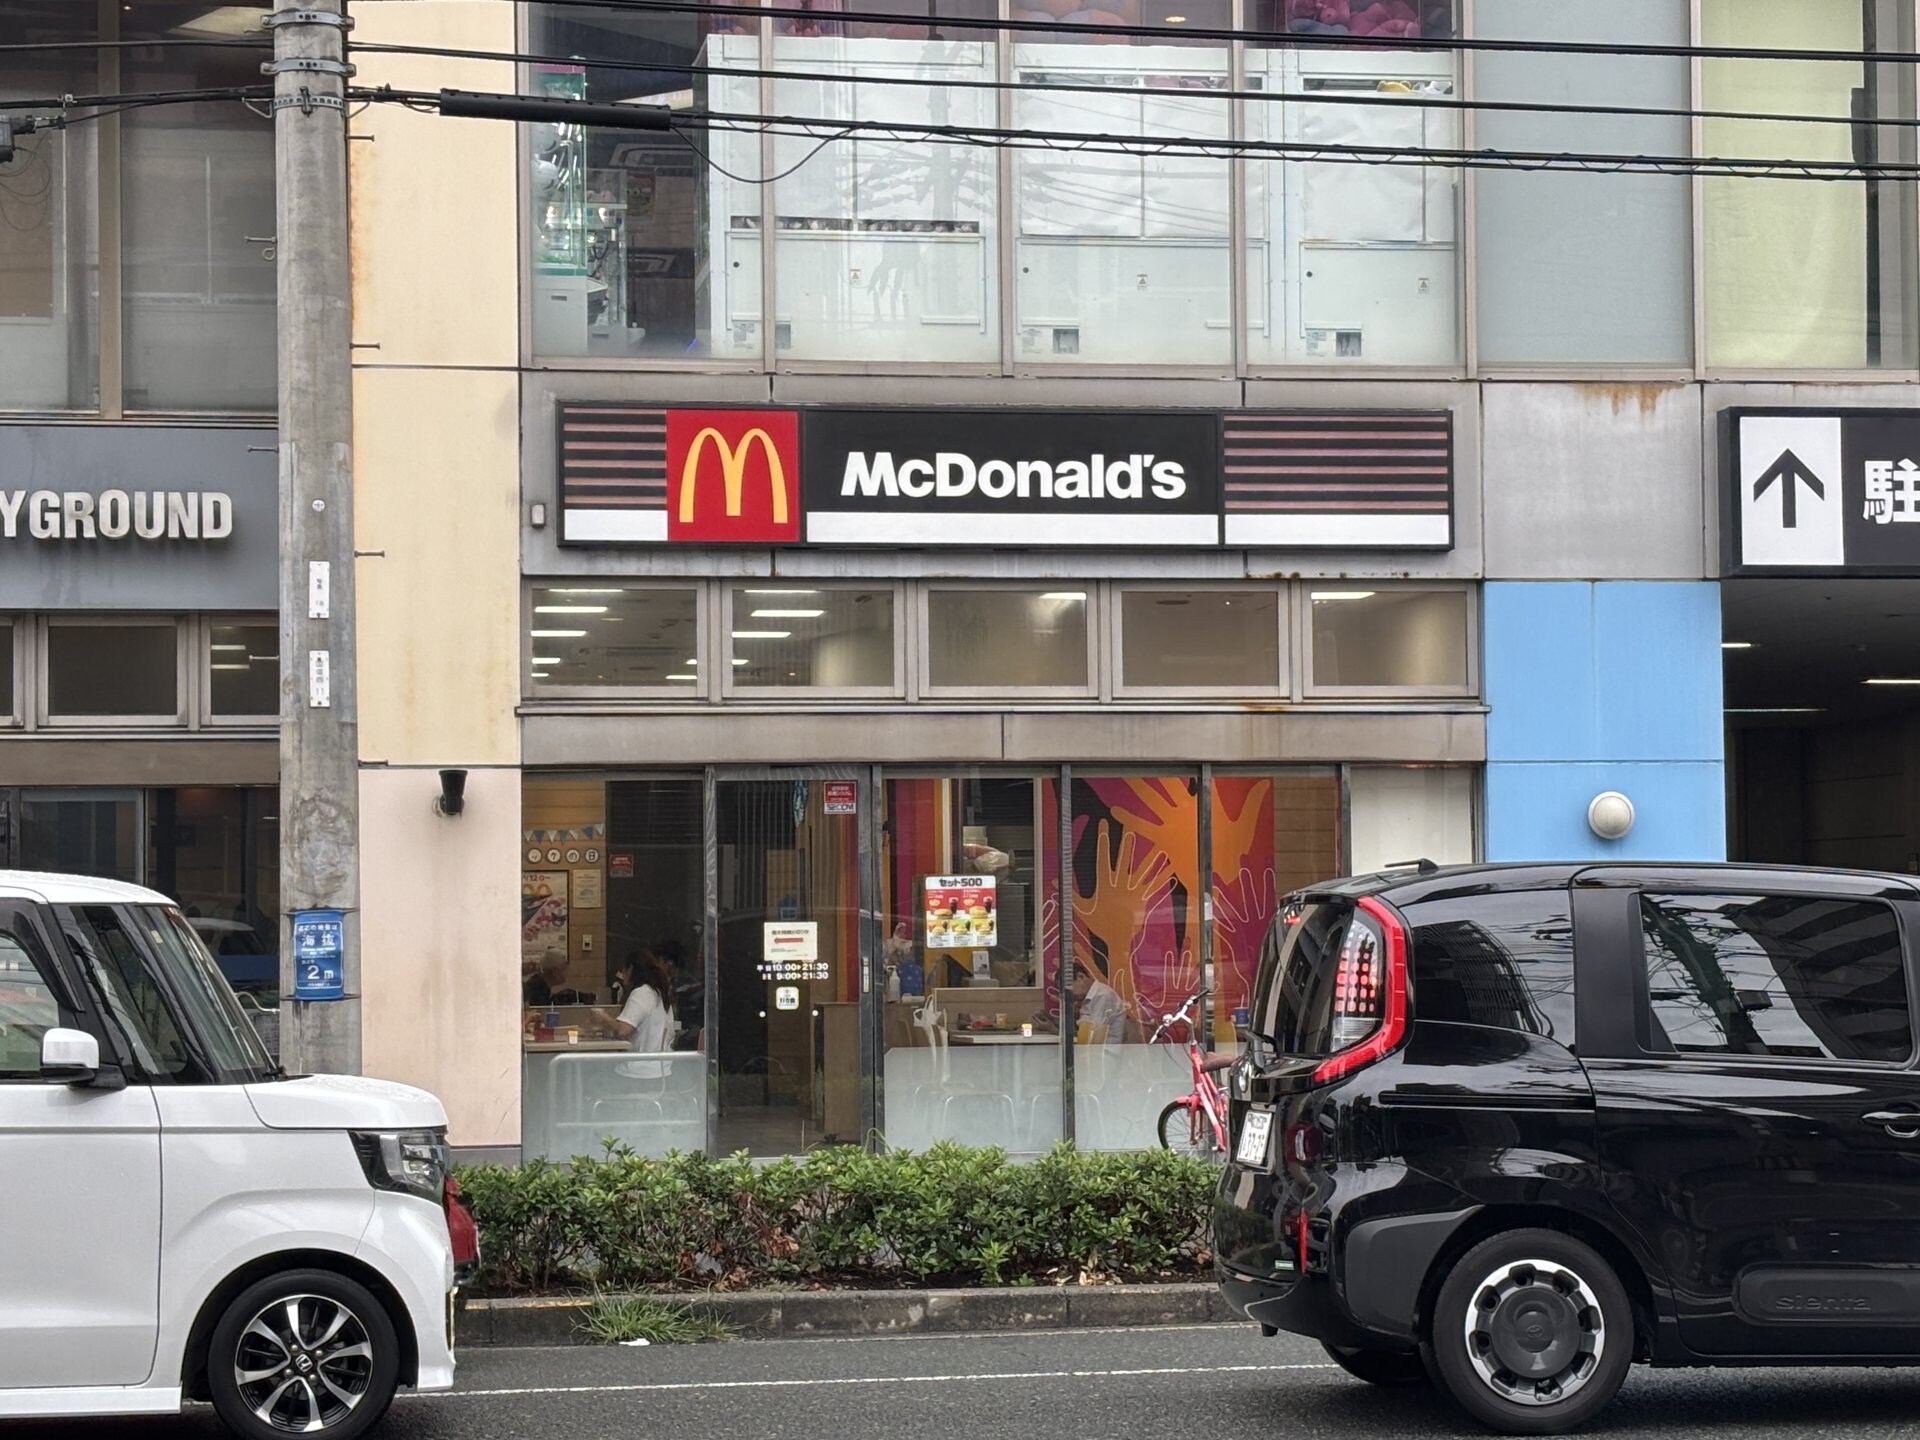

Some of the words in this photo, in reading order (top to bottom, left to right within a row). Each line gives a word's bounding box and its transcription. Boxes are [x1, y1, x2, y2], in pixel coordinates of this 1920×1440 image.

[841, 451, 1187, 501] McDonald's
[1862, 458, 1920, 524] 駐
[0, 489, 233, 540] YGROUND
[939, 878, 983, 887] セット500
[307, 965, 320, 980] 2
[323, 969, 334, 979] m
